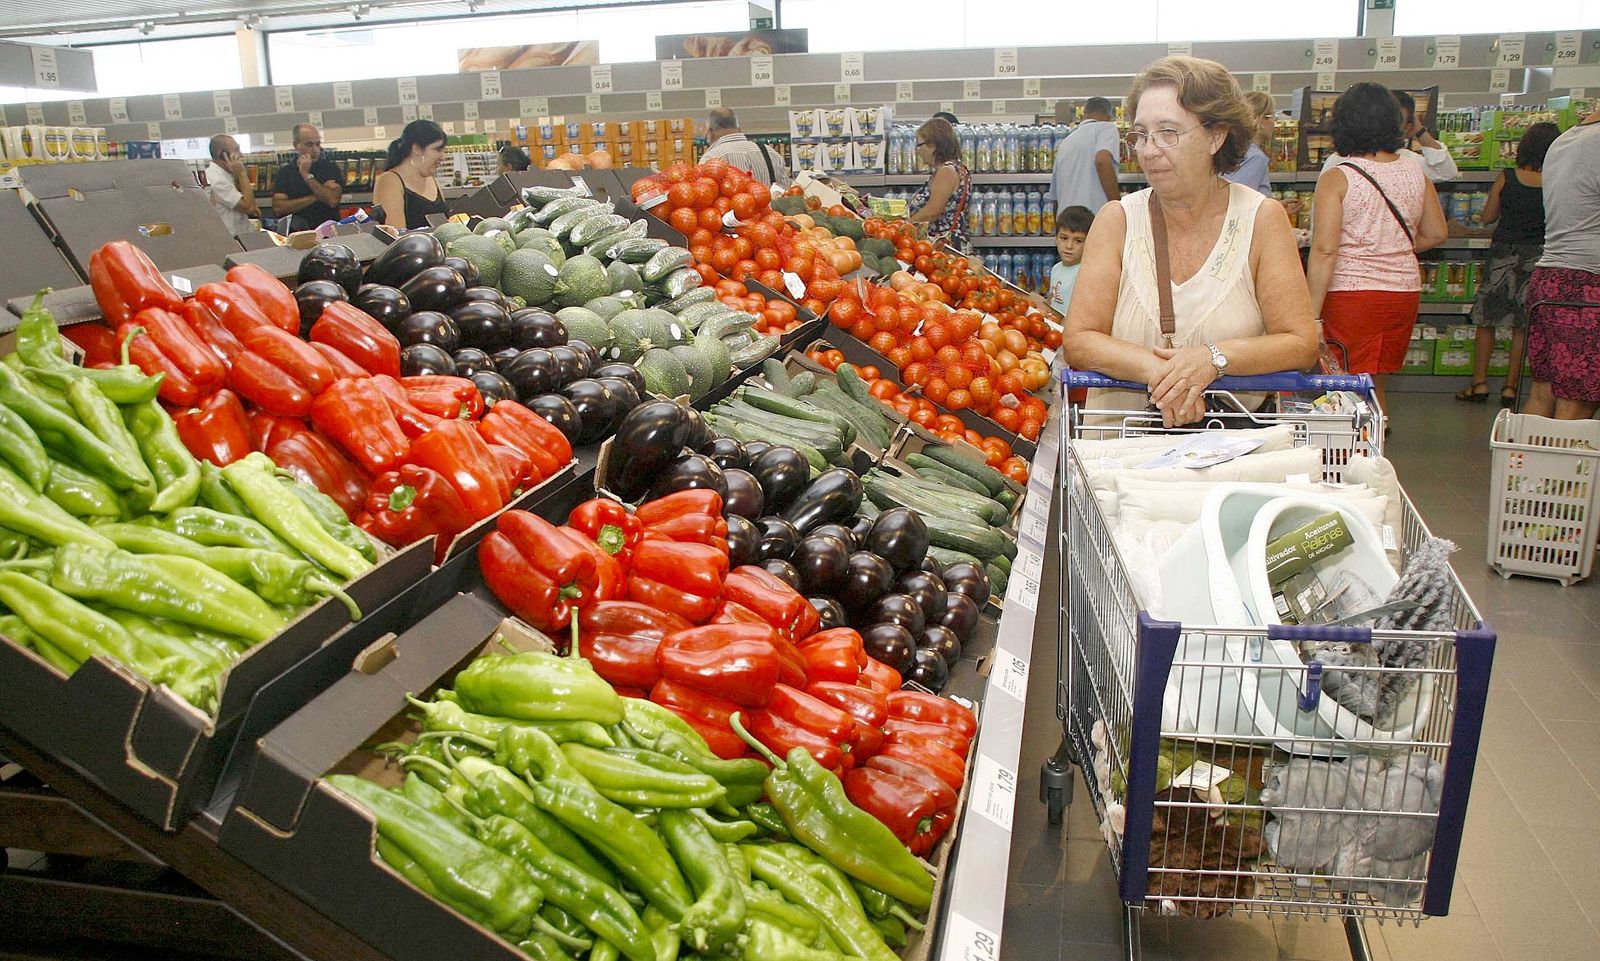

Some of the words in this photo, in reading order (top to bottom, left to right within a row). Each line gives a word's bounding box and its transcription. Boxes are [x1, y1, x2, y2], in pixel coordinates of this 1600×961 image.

[1380, 55, 1397, 64] 1,89
[1503, 53, 1520, 62] 1,29
[1558, 50, 1576, 59] 2,99
[1316, 57, 1333, 65] 2,49
[1439, 56, 1456, 64] 1,79
[999, 65, 1017, 73] 0,99
[1304, 519, 1338, 540] Aceitunas
[1315, 543, 1335, 555] ANCHOA
[1266, 544, 1297, 565] ultivador
[1012, 657, 1027, 678] 1,05
[997, 768, 1015, 794] 1,79
[973, 931, 994, 961] 1,29
